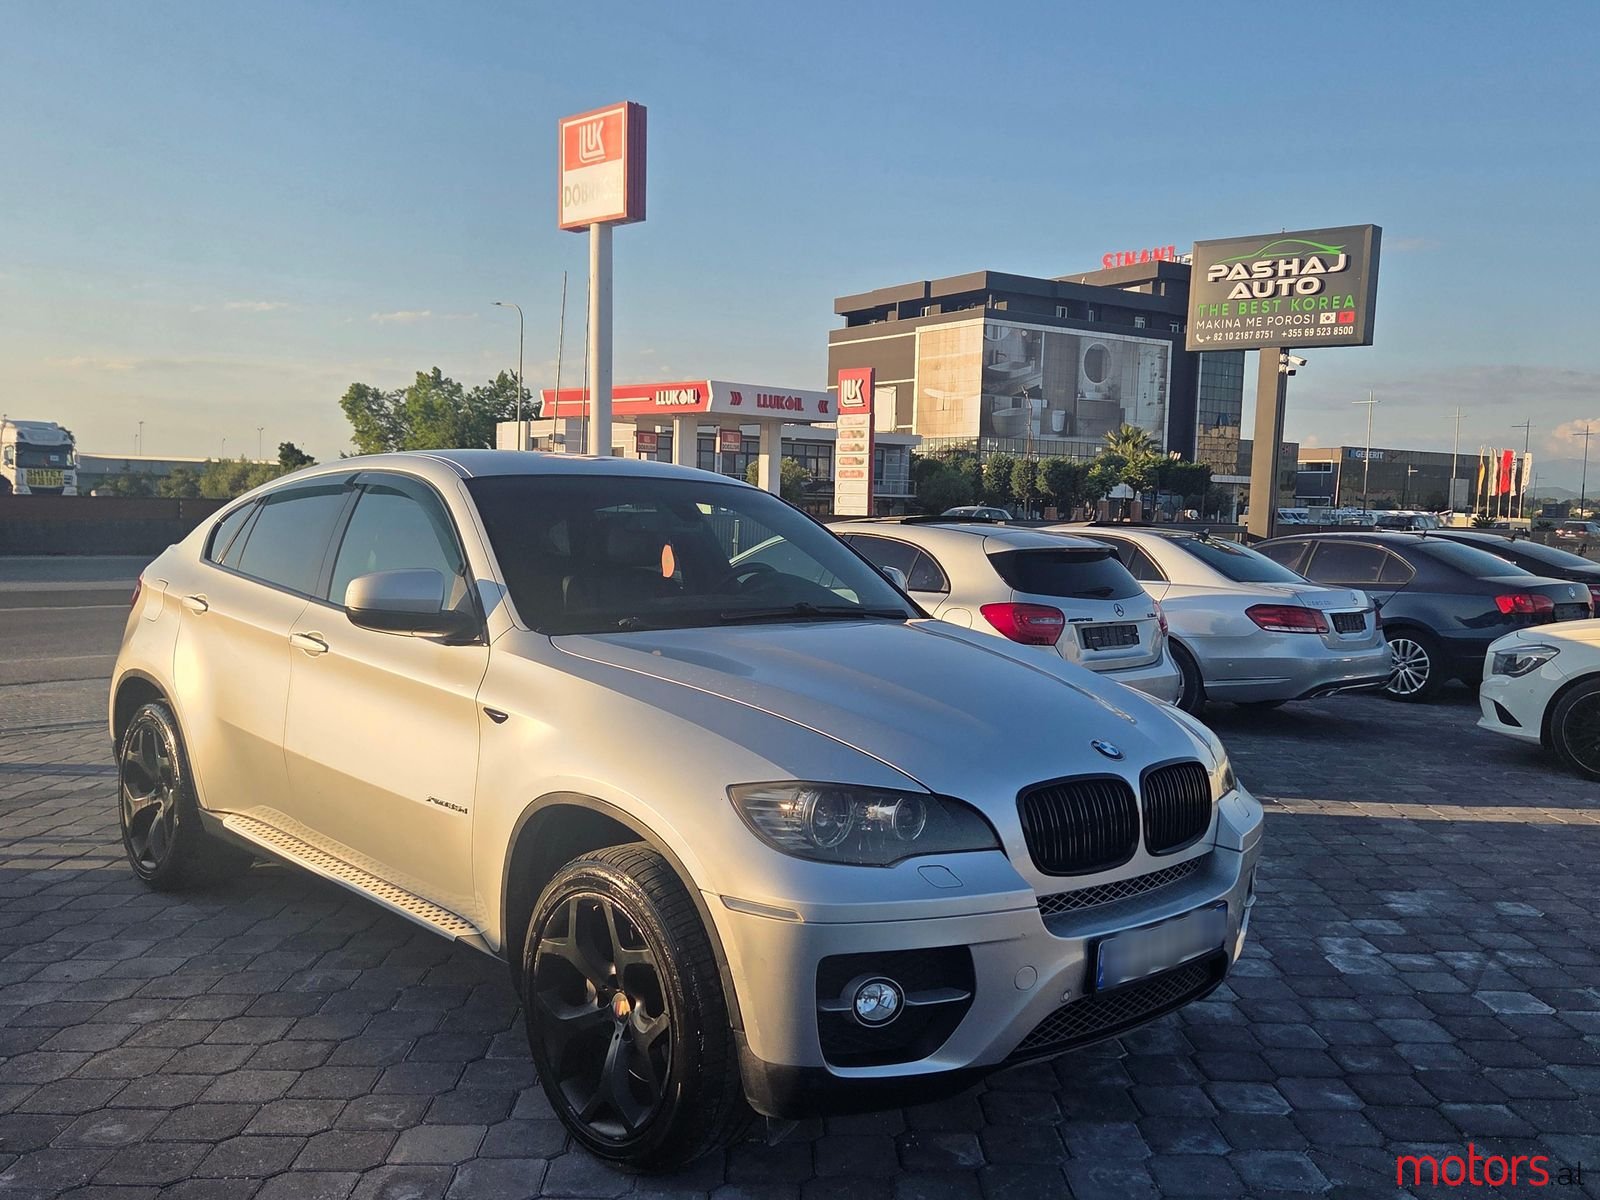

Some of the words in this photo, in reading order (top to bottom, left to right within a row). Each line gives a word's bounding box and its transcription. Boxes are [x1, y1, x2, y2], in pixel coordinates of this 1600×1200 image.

[1207, 253, 1347, 282] PASHAJ
[1227, 276, 1321, 300] AUTO
[1198, 303, 1229, 318] THE
[1238, 299, 1281, 315] BEST
[1291, 294, 1355, 312] KOREA
[1196, 318, 1241, 330] MAKINA
[1246, 316, 1263, 327] ME
[1267, 313, 1315, 326] POROSI
[1281, 328, 1302, 338] +355
[1304, 327, 1315, 337] 69
[1316, 326, 1331, 336] 523
[1333, 325, 1354, 335] 8500
[1225, 331, 1234, 340] 10
[1235, 330, 1254, 340] 2187
[1255, 329, 1274, 339] 8751
